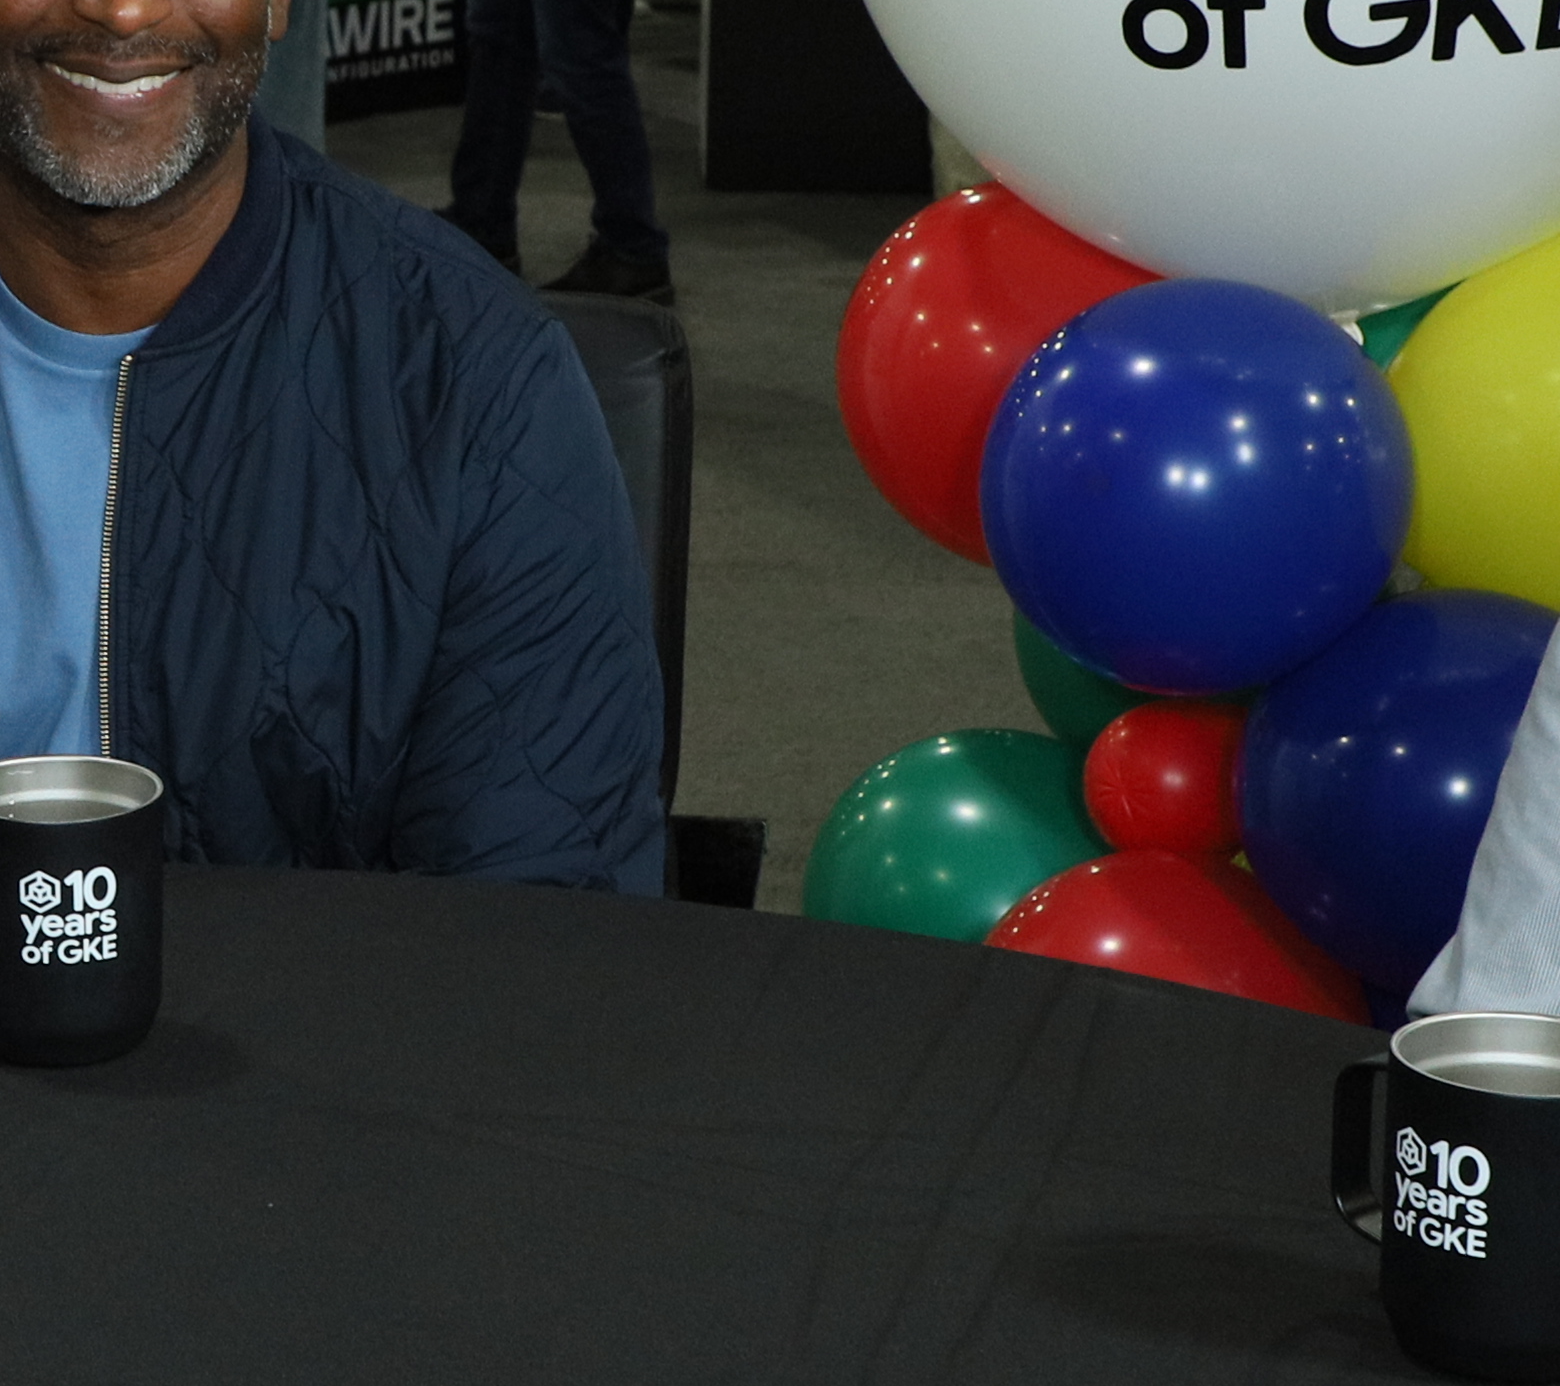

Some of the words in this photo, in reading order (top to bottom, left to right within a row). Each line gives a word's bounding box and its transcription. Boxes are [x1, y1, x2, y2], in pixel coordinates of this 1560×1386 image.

[63, 866, 118, 912] 10
[19, 908, 118, 944] years
[21, 941, 53, 964] of
[57, 933, 118, 965] GKE
[1429, 1139, 1491, 1197] 10
[1394, 1171, 1488, 1227] years
[1393, 1208, 1418, 1238] of
[1418, 1216, 1488, 1260] GKE
